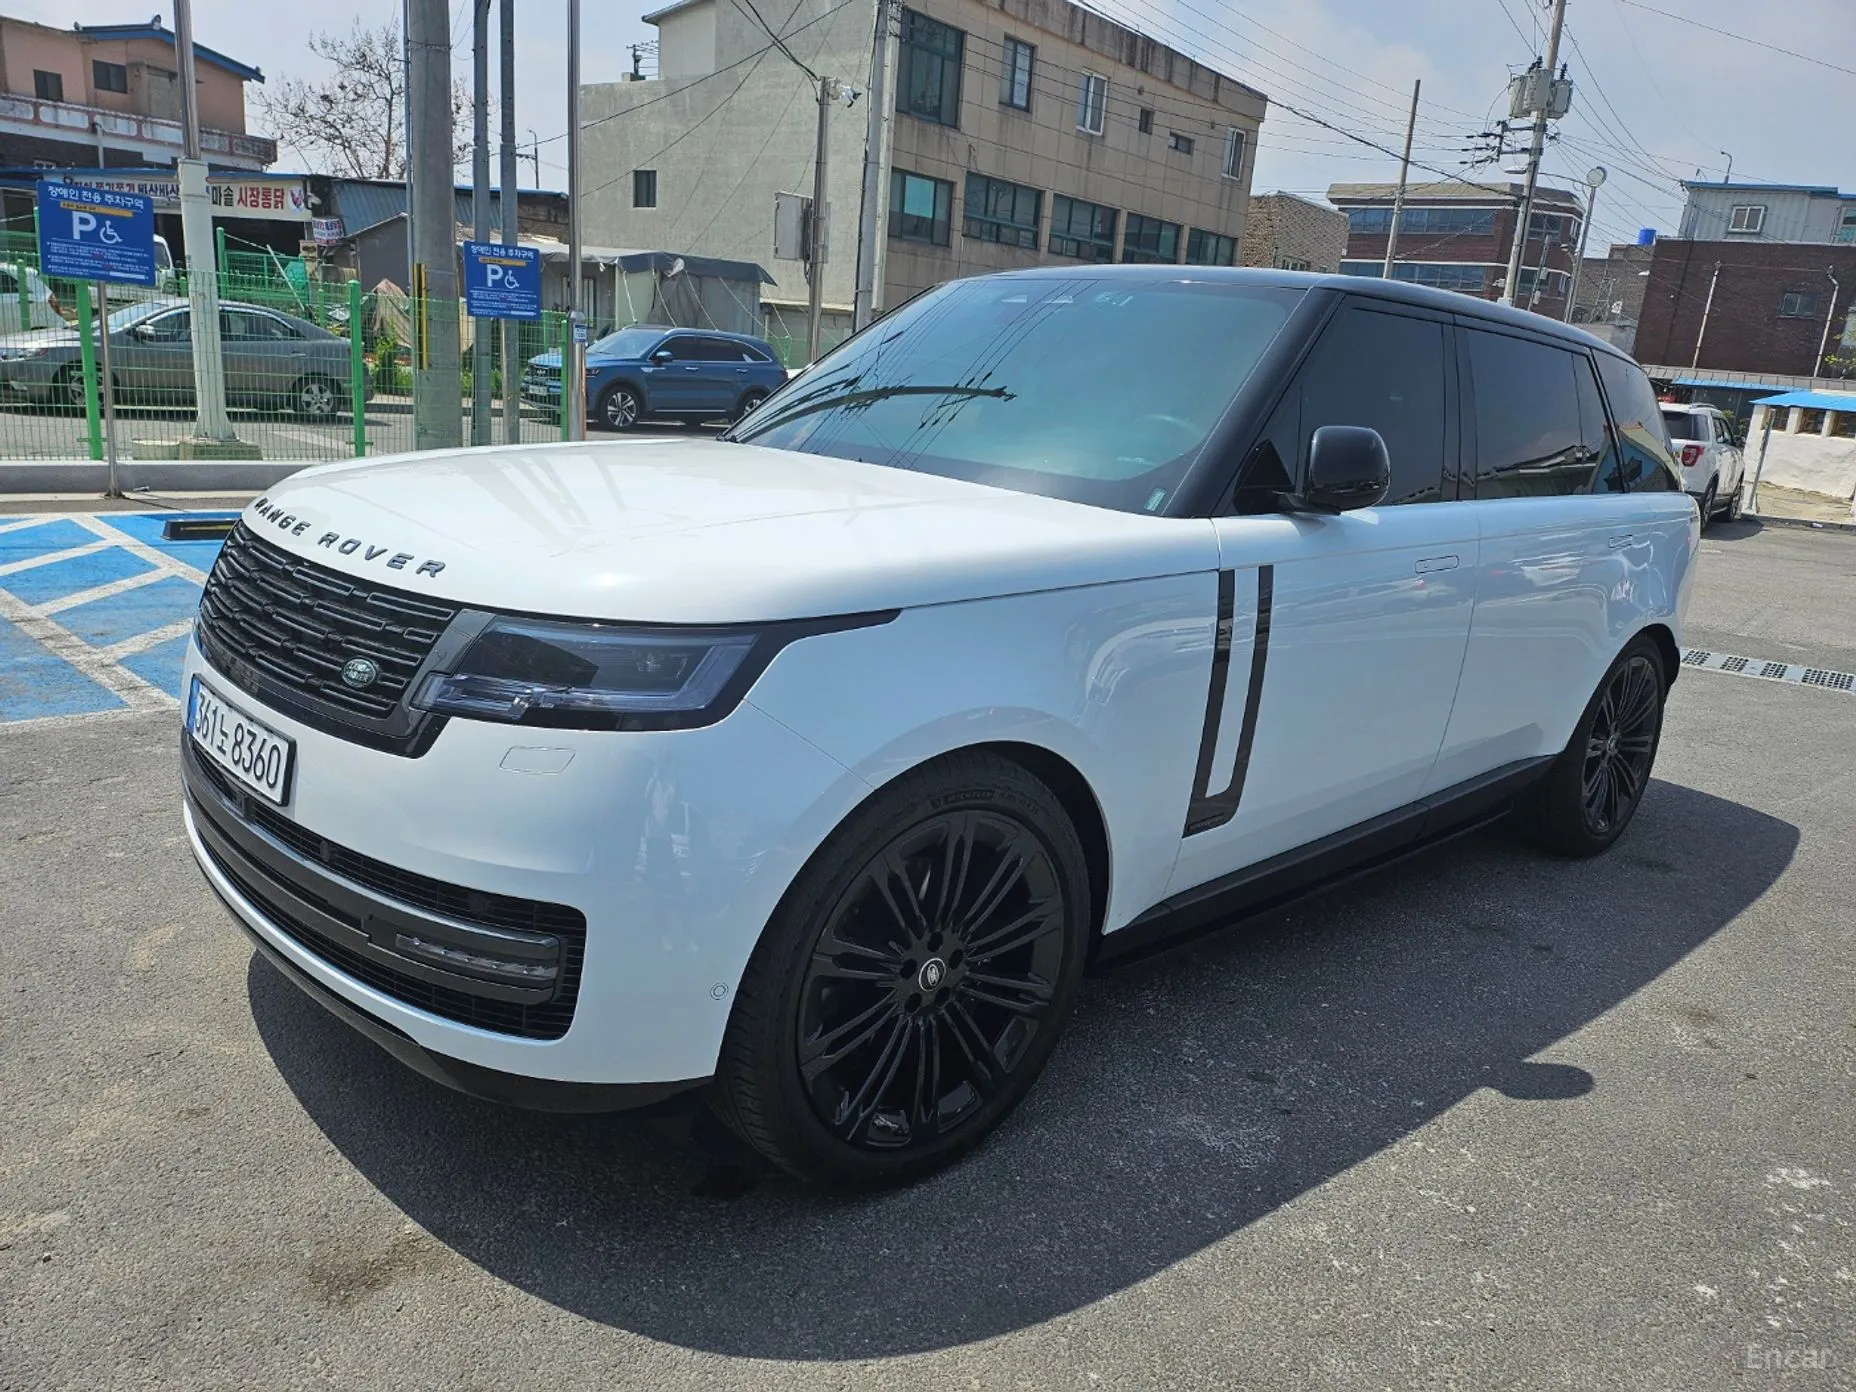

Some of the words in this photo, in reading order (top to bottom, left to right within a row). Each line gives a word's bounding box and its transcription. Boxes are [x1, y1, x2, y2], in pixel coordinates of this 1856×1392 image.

[48, 185, 79, 200] 장애인
[82, 190, 102, 203] 전용
[105, 193, 144, 210] 주차구역
[237, 186, 284, 209] 시장통닭
[72, 210, 97, 240] P
[486, 263, 503, 288] P
[254, 497, 312, 537] RANGE
[317, 531, 446, 578] ROVER
